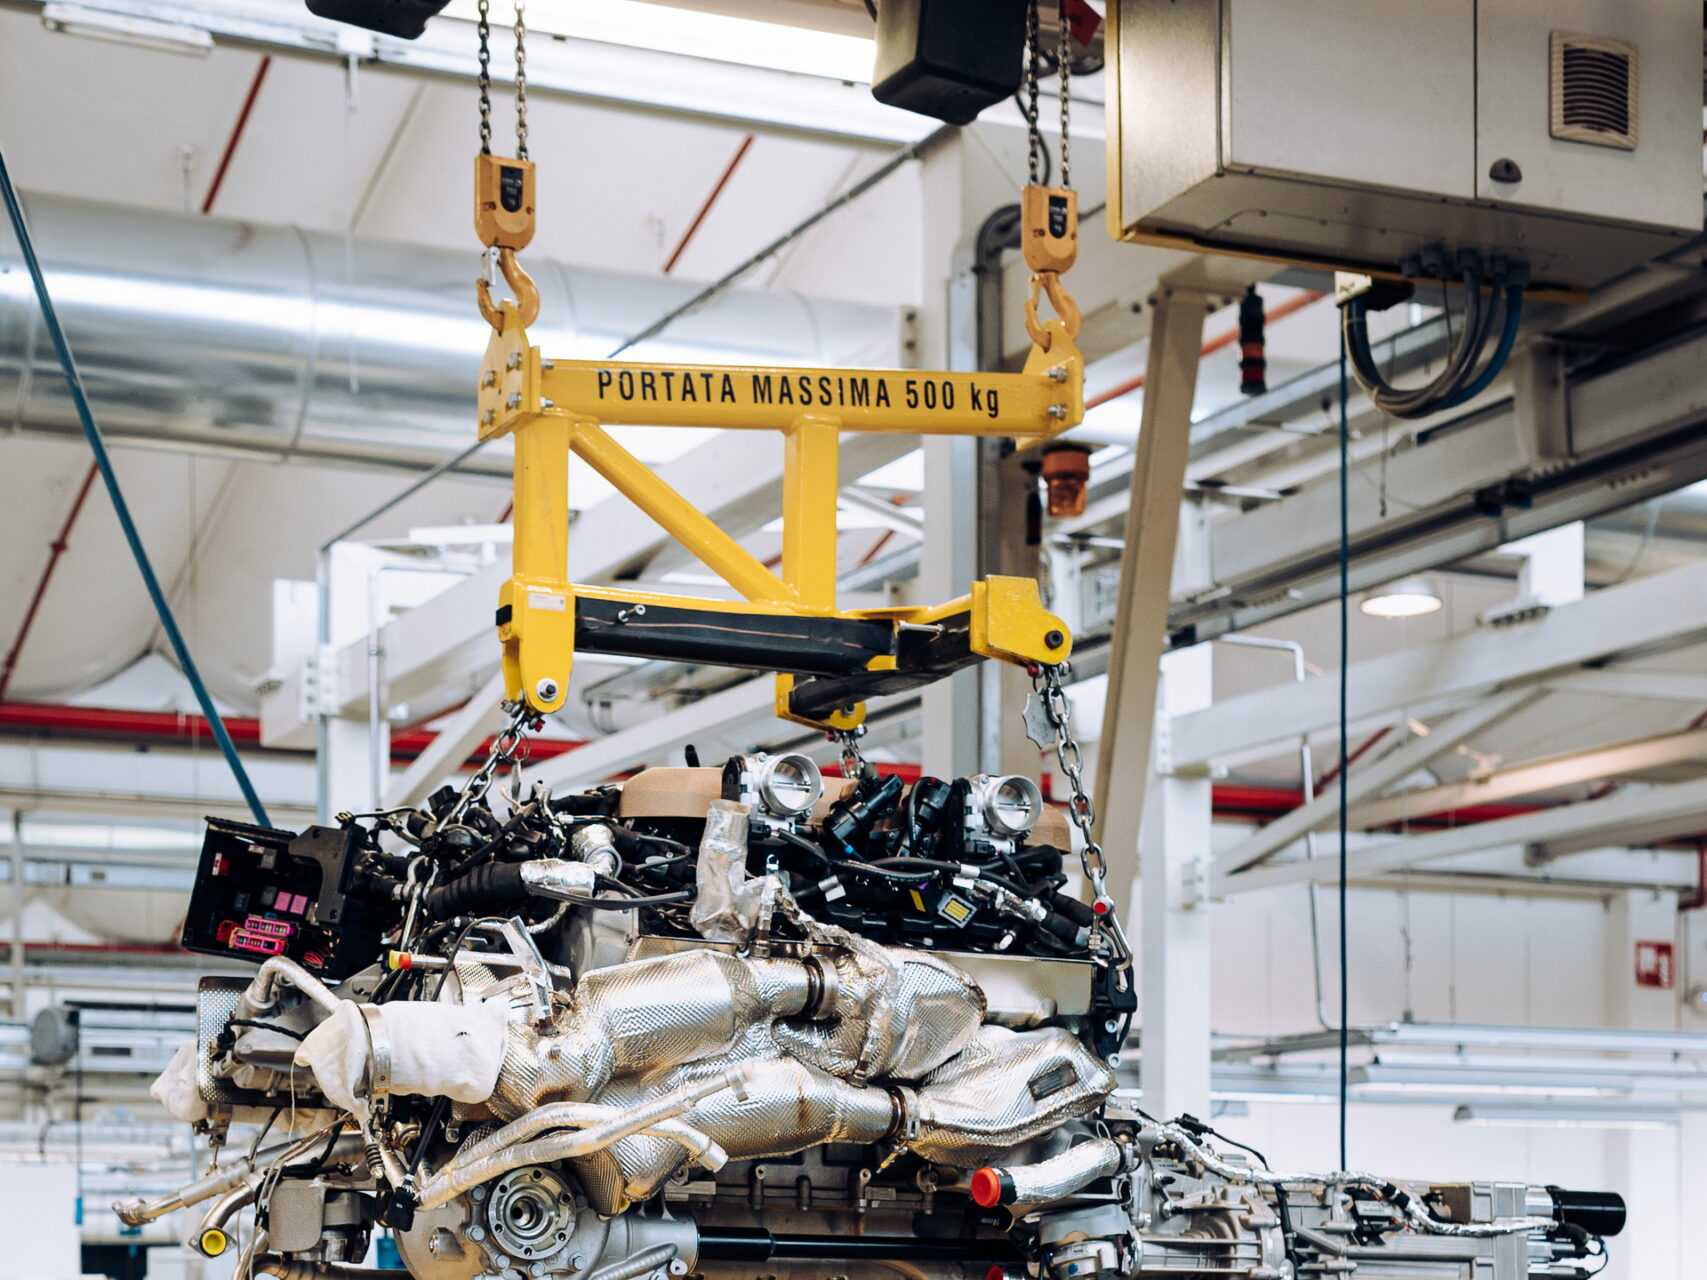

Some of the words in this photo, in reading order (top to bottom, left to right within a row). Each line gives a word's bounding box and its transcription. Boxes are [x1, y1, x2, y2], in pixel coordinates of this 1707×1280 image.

[597, 369, 737, 404] PORTATA
[752, 374, 892, 408] MASSIMA
[905, 380, 955, 410] 500
[970, 382, 999, 418] kg
